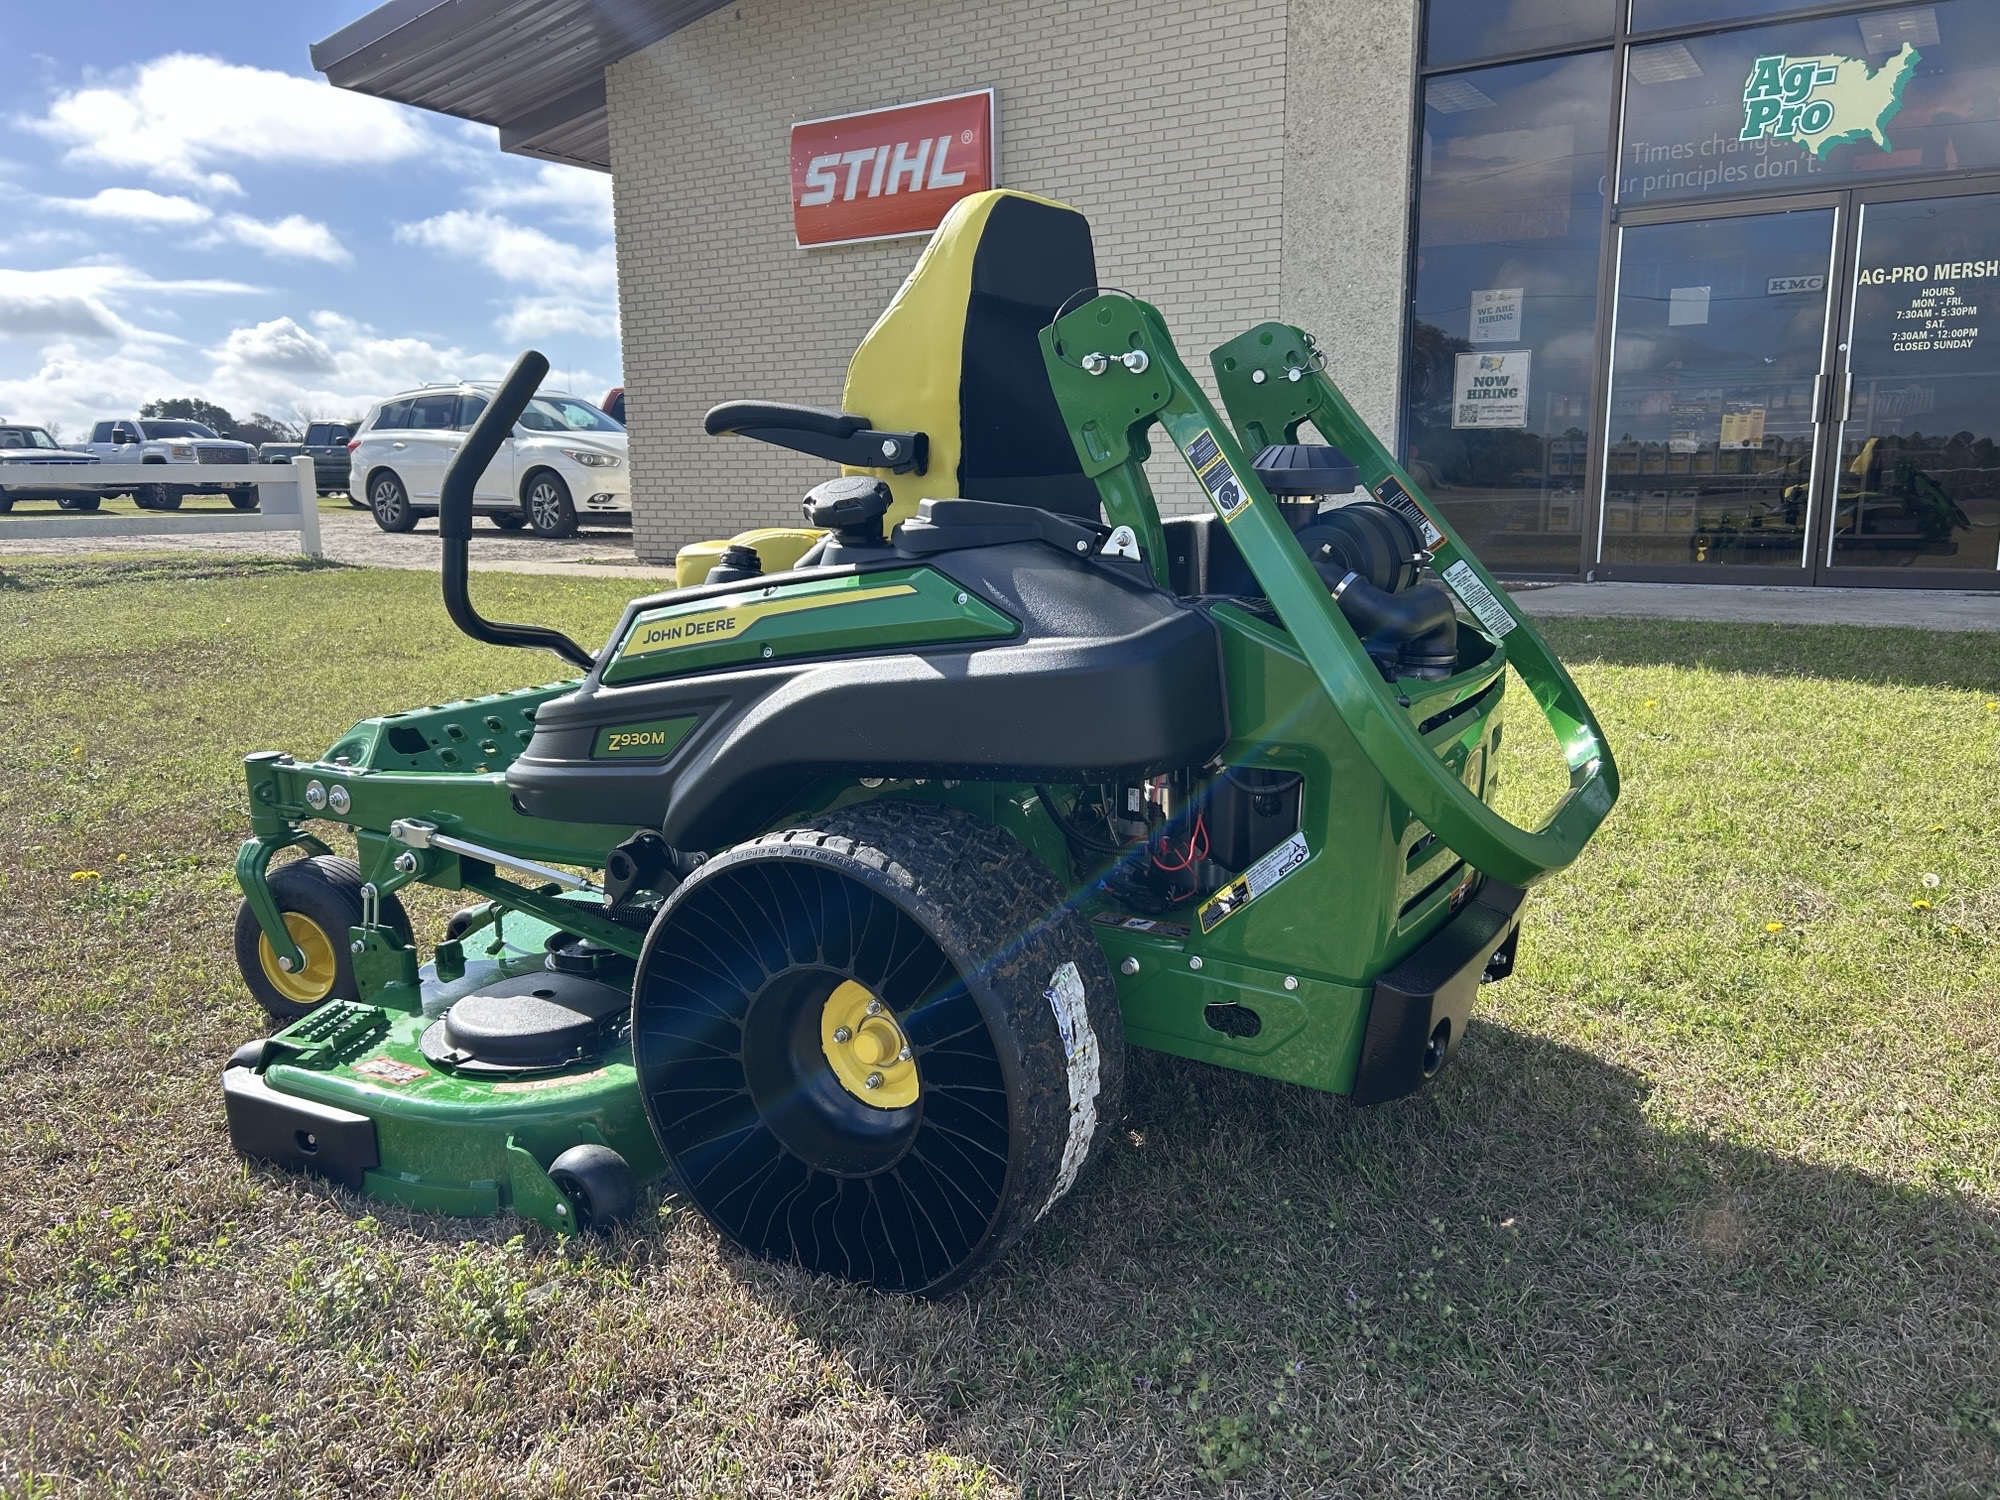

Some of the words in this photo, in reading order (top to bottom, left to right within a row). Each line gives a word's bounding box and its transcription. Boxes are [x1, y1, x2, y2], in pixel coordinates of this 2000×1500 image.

[1744, 55, 1837, 103] Ag-
[1739, 98, 1833, 141] Pro
[1632, 139, 1693, 164] Times
[800, 136, 965, 206] STIHL
[1642, 161, 1748, 197] principles
[1858, 266, 1929, 285] AG-PRO
[1934, 260, 2000, 280] MERSH
[1770, 278, 1821, 291] KMC
[1922, 287, 1955, 297] HOURS
[1912, 299, 1937, 308] MON.
[1946, 297, 1963, 306] FRI.
[1477, 307, 1494, 316] WE
[1495, 304, 1515, 314] ARE
[1896, 309, 1932, 319] 7:30AM
[1941, 306, 1977, 317] 5:30PM
[1478, 313, 1514, 324] HIRING
[1925, 319, 1945, 329] SAT.
[1892, 331, 1927, 341] 7:30AM
[1938, 328, 1978, 338] 12:00PM
[1893, 341, 1931, 351] CLOSED
[1933, 339, 1973, 349] SUNDAY
[1473, 376, 1510, 388] NOW
[1467, 388, 1518, 400] HIRING
[643, 627, 681, 644] JOHN
[685, 617, 736, 636] DEERE
[608, 731, 665, 751] Z930M
